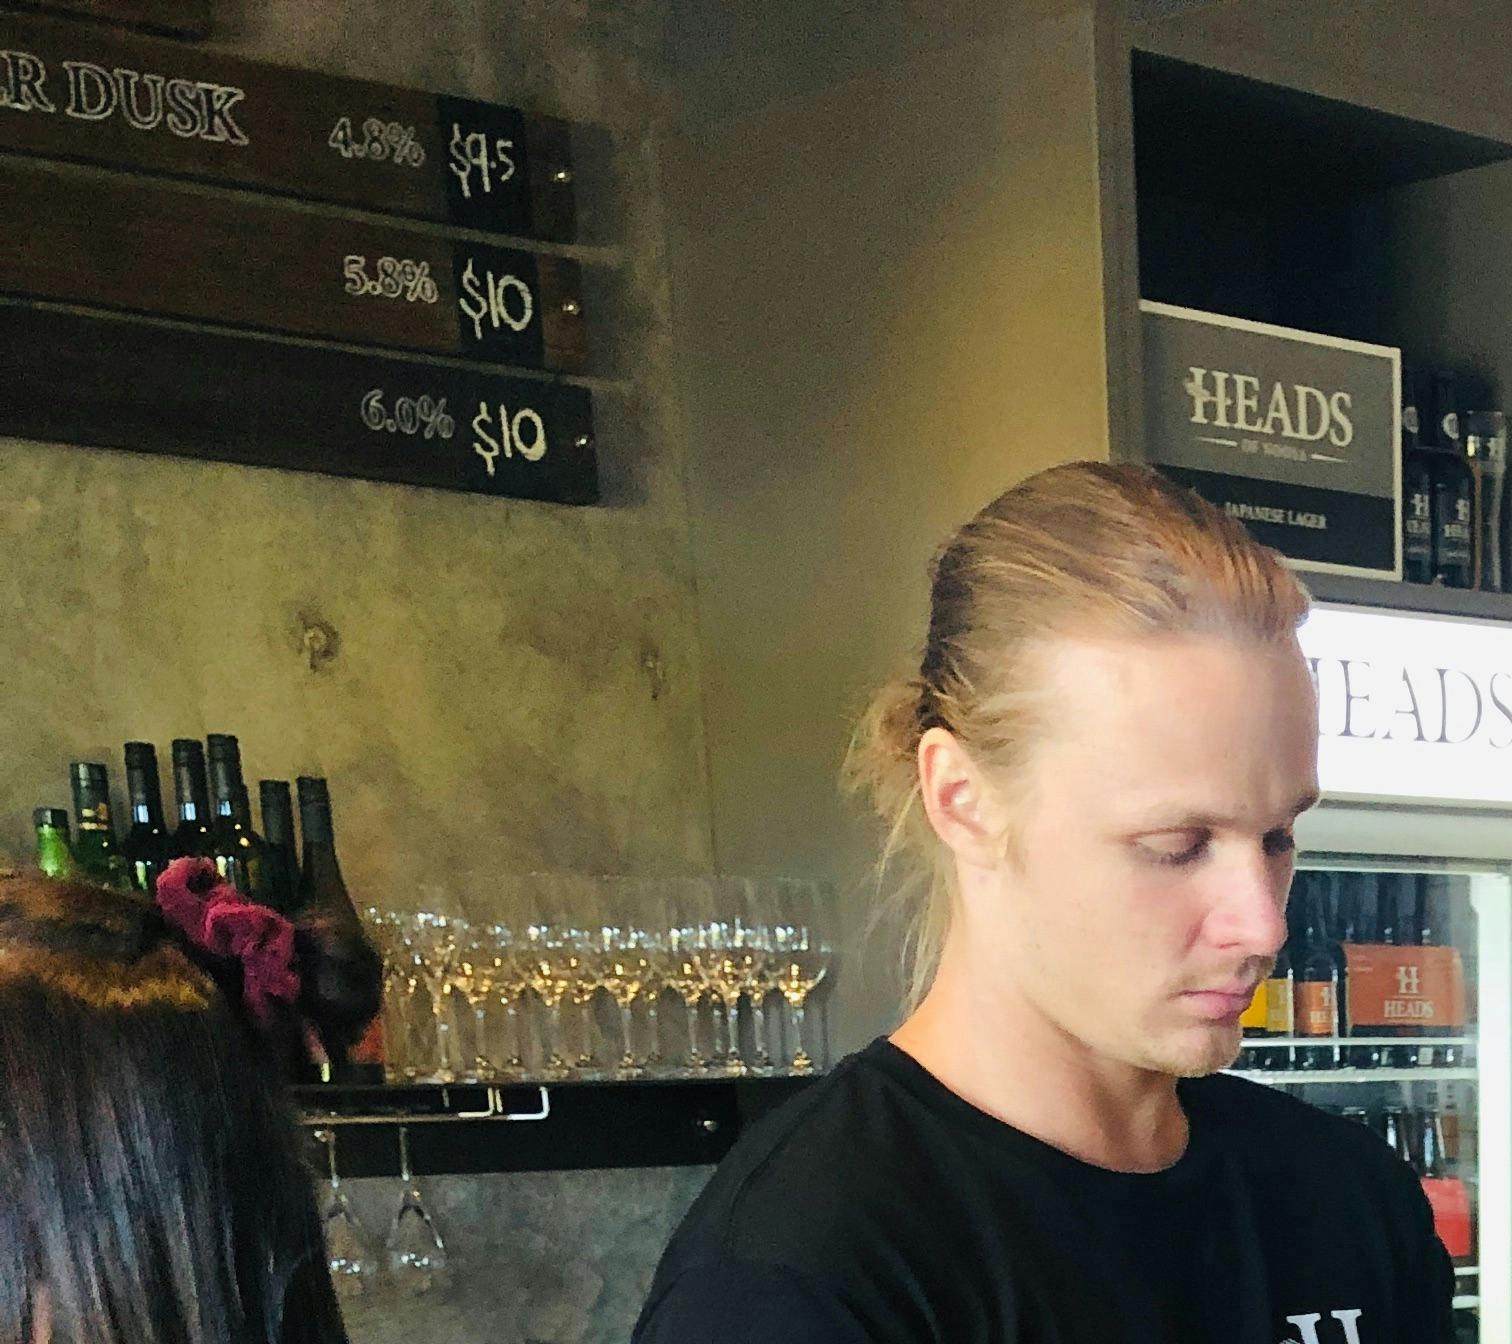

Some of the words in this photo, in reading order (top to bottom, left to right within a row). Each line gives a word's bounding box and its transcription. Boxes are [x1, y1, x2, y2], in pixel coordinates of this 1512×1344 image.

[0, 50, 56, 113] R
[62, 60, 250, 146] DUSK
[328, 116, 426, 167] 4.8%
[450, 122, 516, 198] $9.5
[343, 254, 439, 304] 5.8%
[459, 258, 533, 340] $10
[360, 388, 455, 439] 6.0%
[472, 401, 547, 477] $10
[1184, 366, 1353, 448] HEADS
